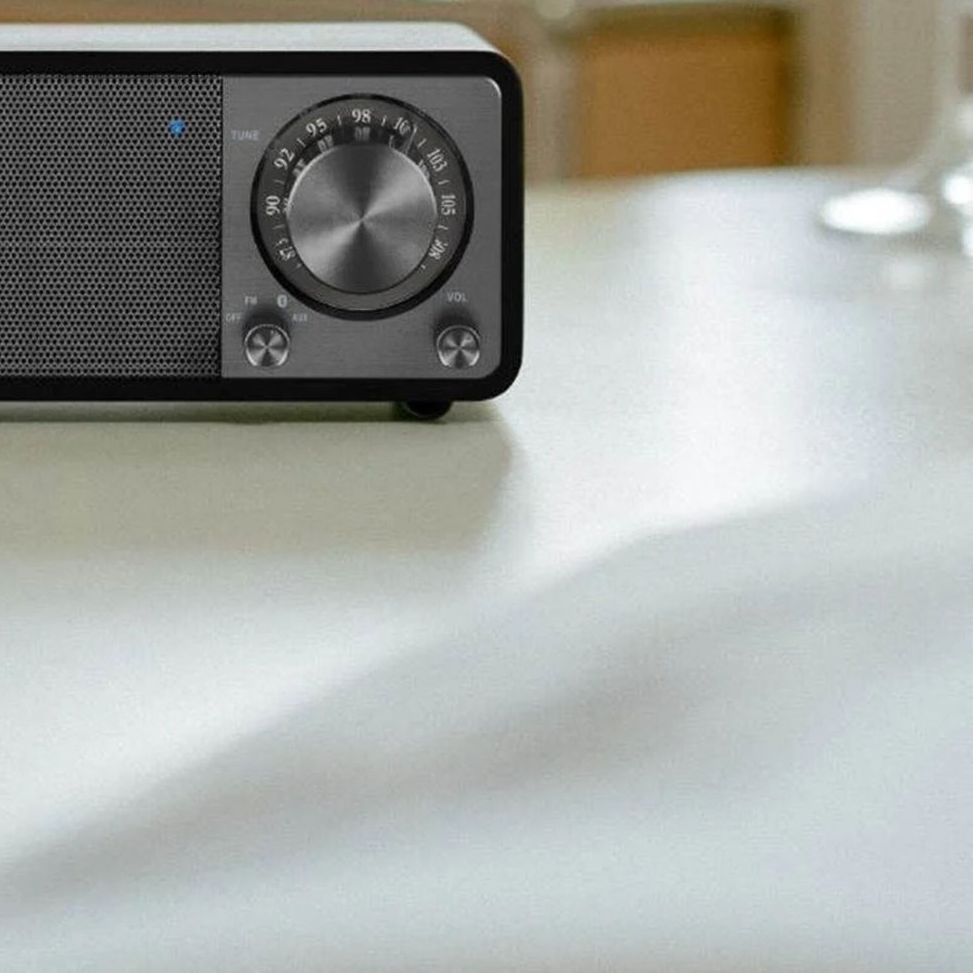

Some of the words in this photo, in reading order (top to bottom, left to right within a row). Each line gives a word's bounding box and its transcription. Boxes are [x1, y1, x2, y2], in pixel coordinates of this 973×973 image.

[352, 108, 371, 124] 98
[230, 130, 259, 141] TUNE
[306, 118, 327, 137] 95
[273, 147, 295, 169] 92
[427, 149, 447, 172] 103
[266, 195, 280, 215] 90
[441, 194, 456, 215] 105
[447, 292, 468, 302] VOL
